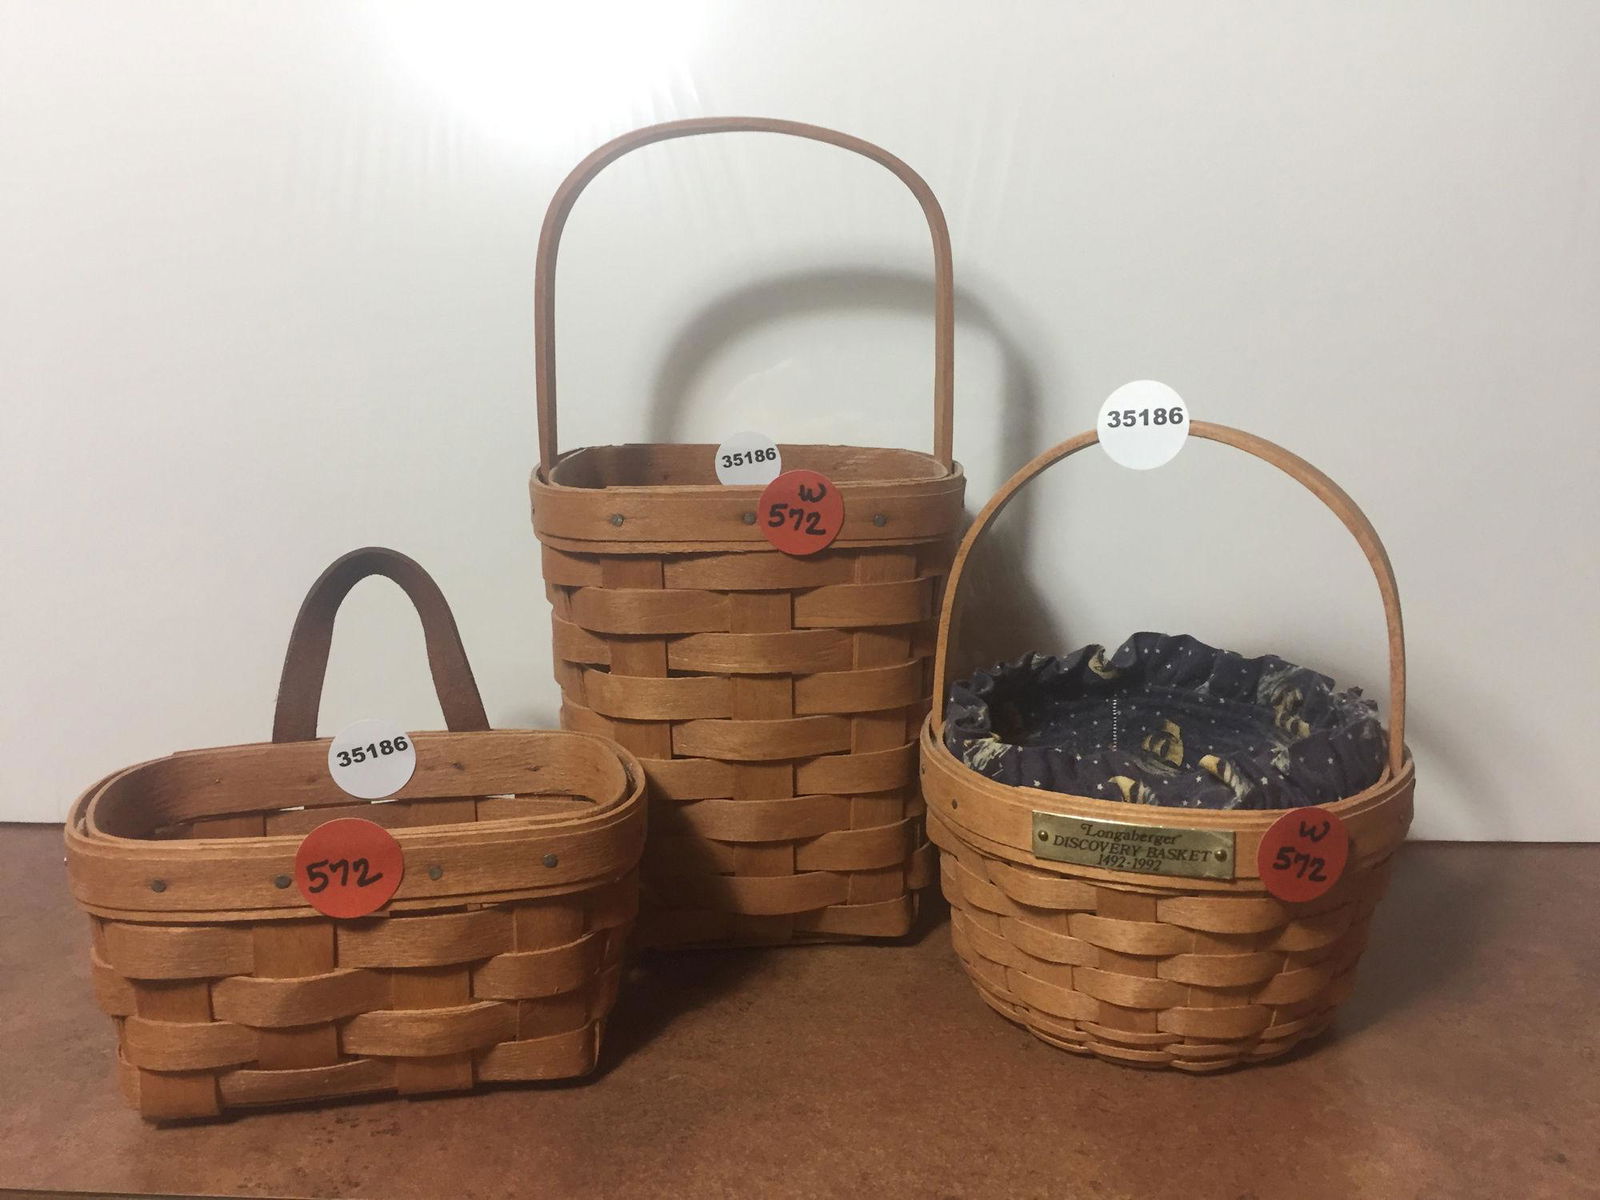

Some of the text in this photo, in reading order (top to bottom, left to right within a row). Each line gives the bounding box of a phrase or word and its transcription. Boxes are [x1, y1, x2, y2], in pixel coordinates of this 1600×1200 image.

[1107, 407, 1184, 428] 35186
[722, 447, 776, 468] 35186
[768, 503, 826, 535] 572
[336, 736, 409, 767] 35186
[1053, 834, 1213, 863] DISCOVERY BASKET
[1080, 823, 1183, 846] Longaberger
[306, 857, 384, 894] 572
[1098, 854, 1162, 872] 1492-1992
[1272, 845, 1327, 882] 572
